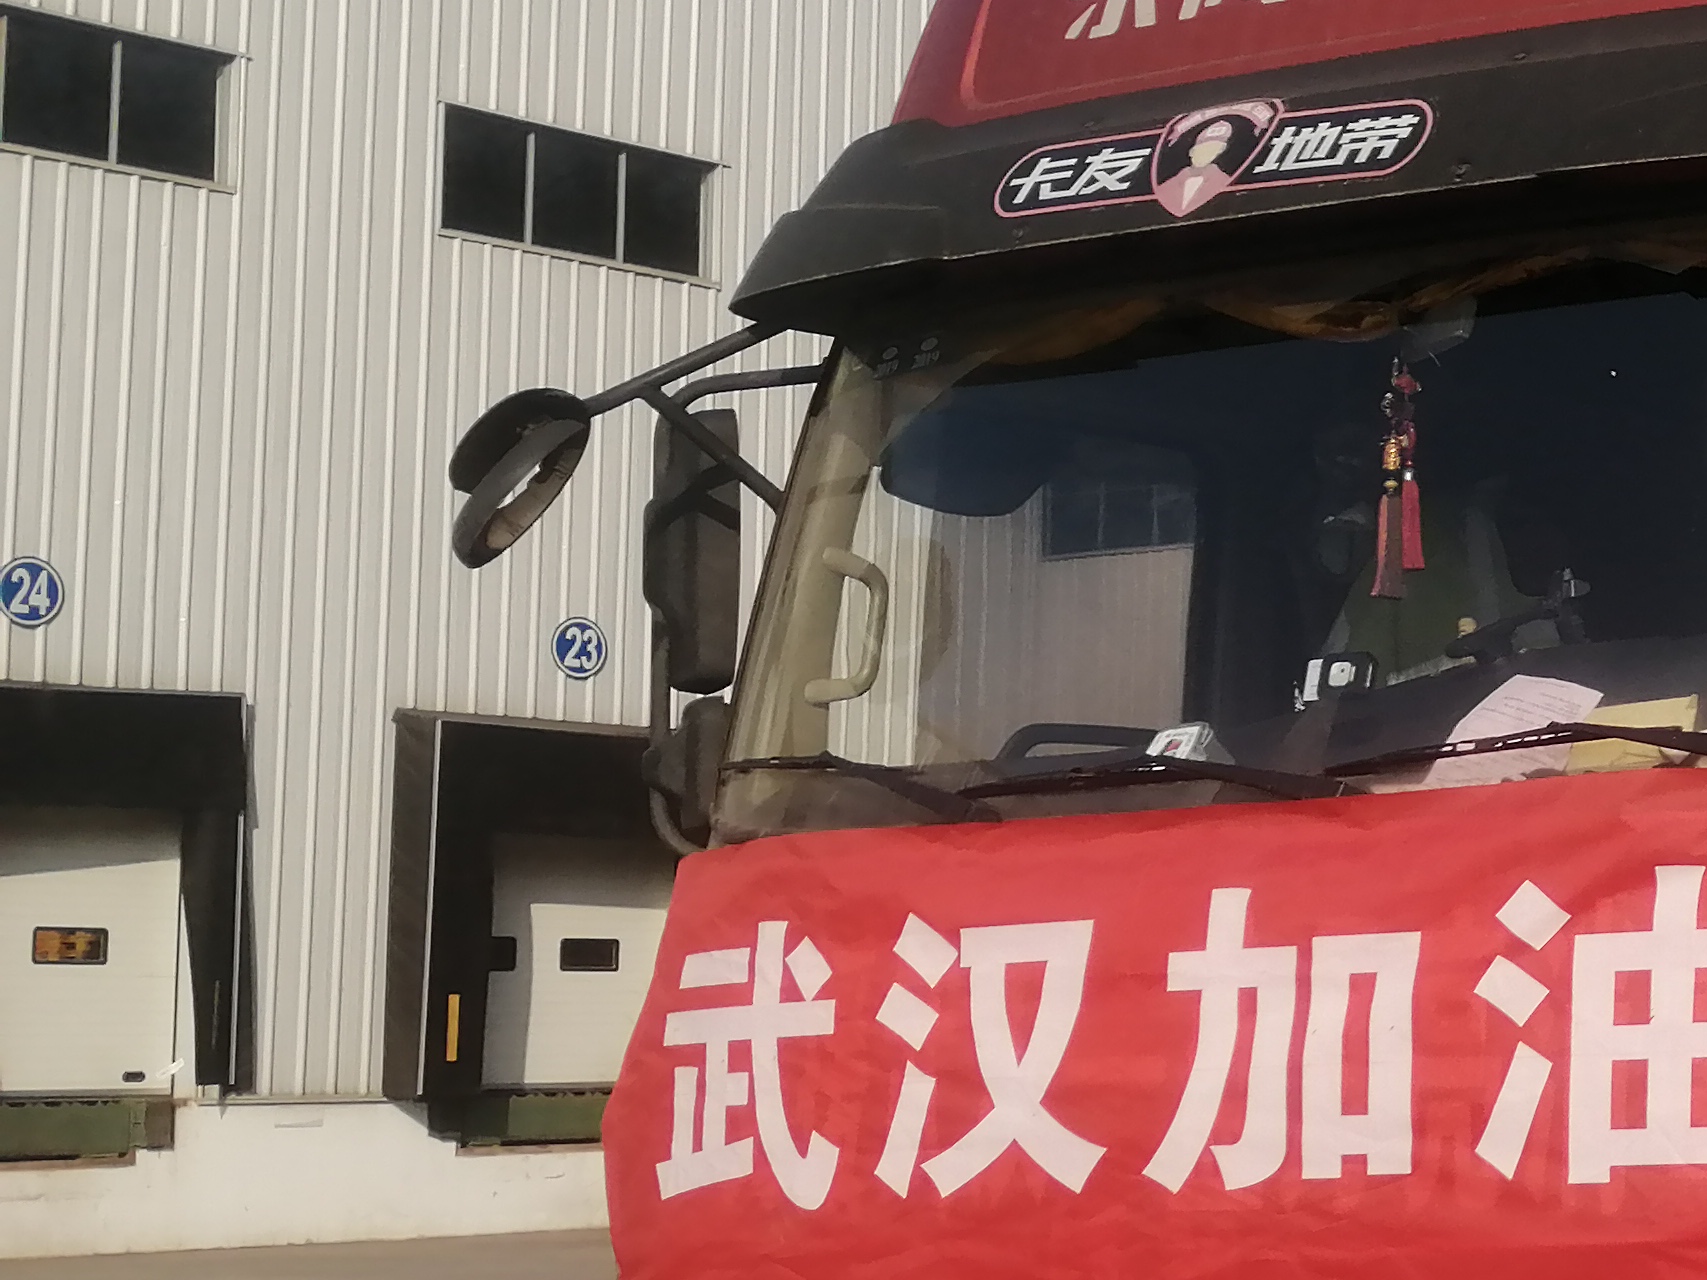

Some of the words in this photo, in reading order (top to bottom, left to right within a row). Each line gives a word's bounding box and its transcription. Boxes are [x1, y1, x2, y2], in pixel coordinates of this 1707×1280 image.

[1008, 147, 1152, 205] 卡友
[1253, 114, 1419, 175] 地带
[10, 568, 51, 616] 24
[563, 625, 600, 670] 23
